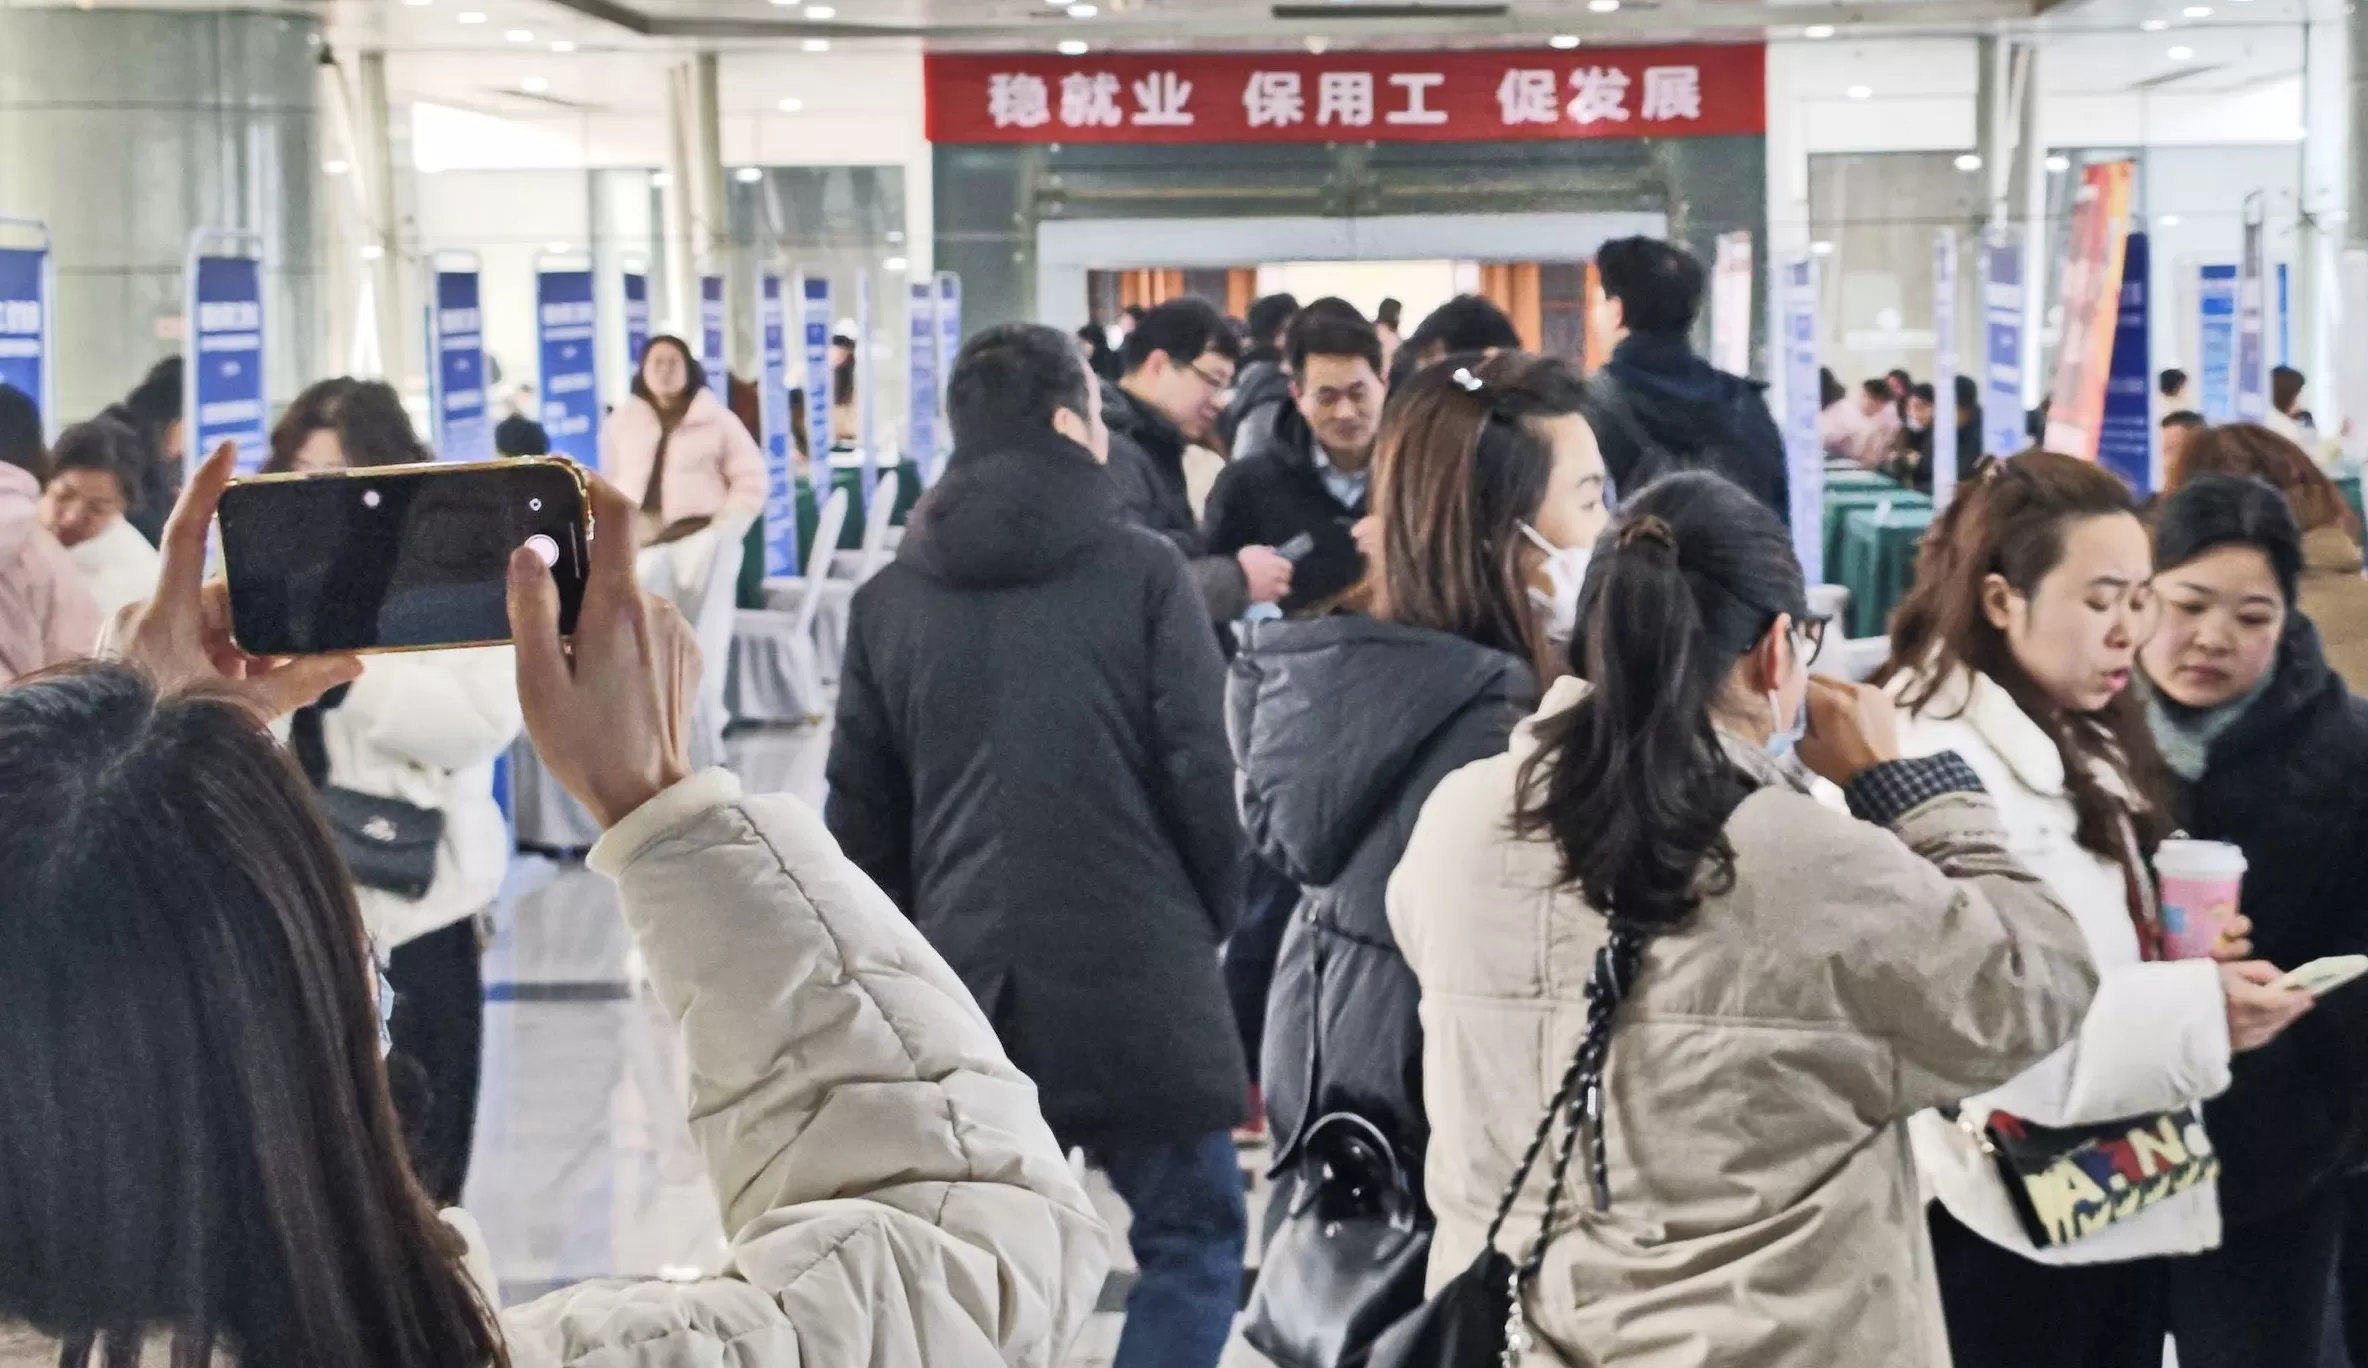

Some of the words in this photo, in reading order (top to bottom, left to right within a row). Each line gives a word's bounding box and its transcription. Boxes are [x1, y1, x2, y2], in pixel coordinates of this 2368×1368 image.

[986, 72, 1194, 127] 稳就业
[1243, 71, 1449, 127] 保用工
[1497, 65, 1702, 125] 促发展
